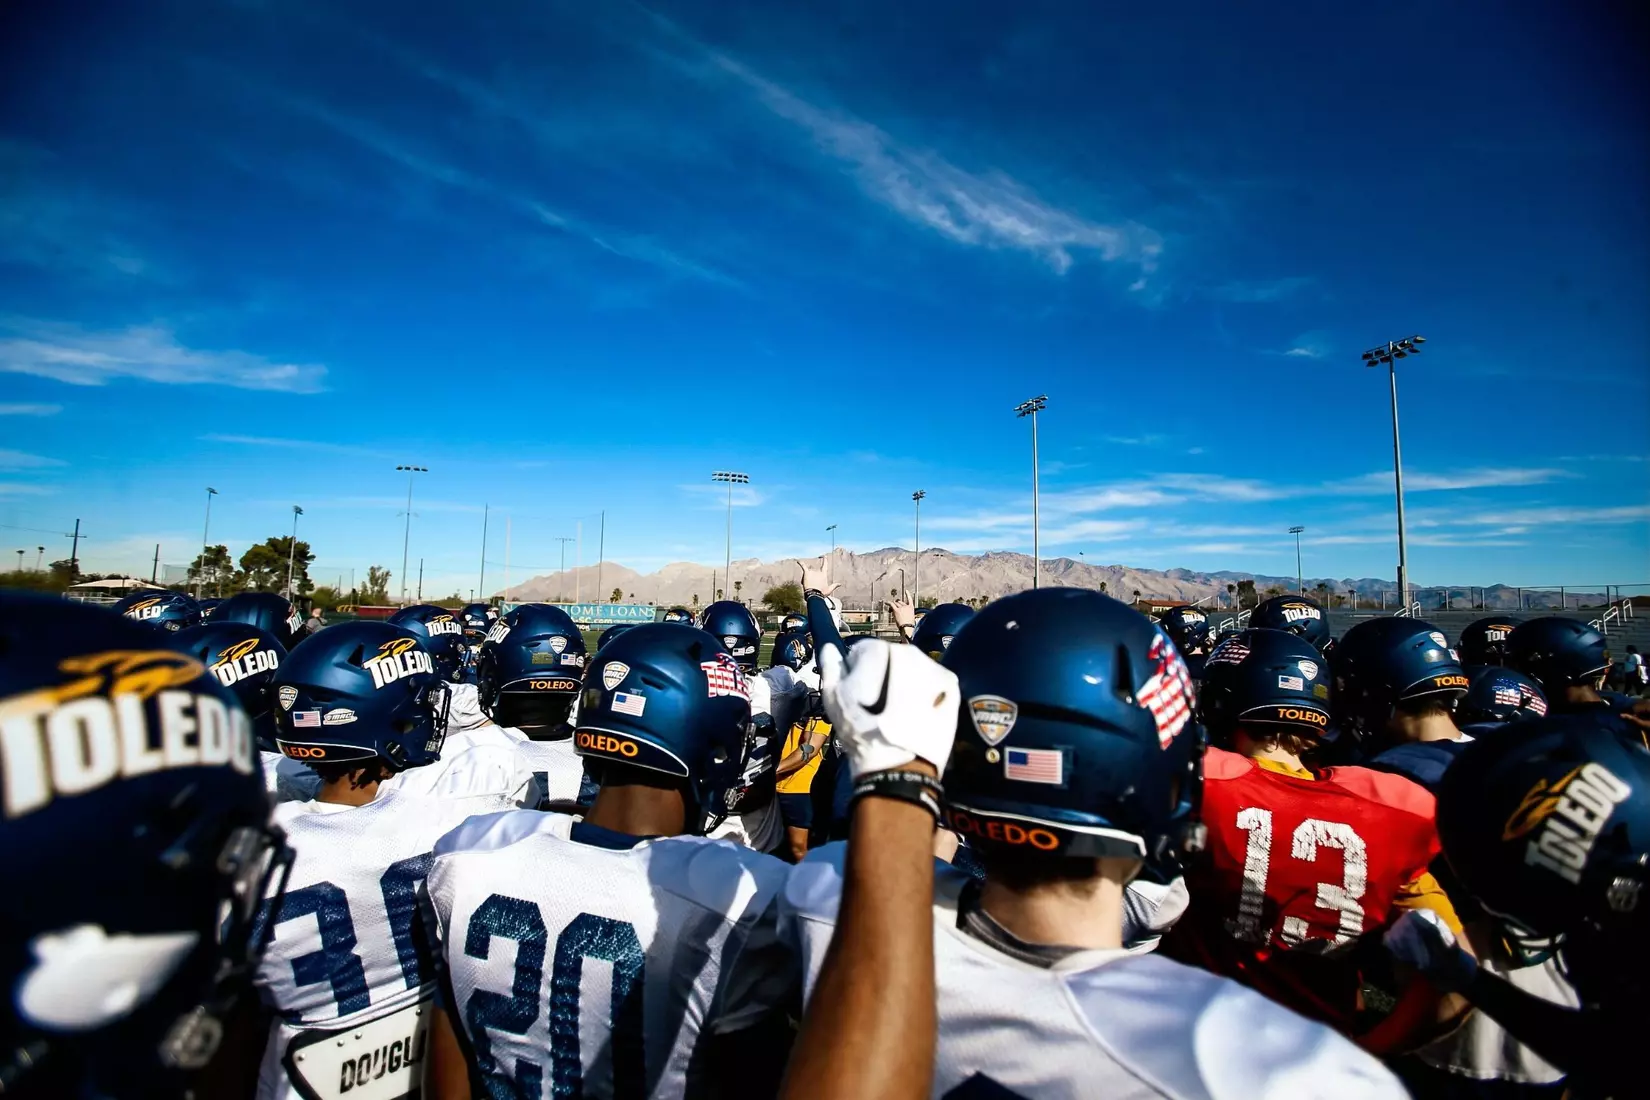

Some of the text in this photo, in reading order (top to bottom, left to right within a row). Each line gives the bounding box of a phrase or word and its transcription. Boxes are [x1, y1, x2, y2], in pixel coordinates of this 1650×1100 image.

[560, 605, 656, 617] HOME LOANS
[1281, 607, 1321, 624] TOLEDO
[424, 621, 462, 638] TOLEDO
[363, 650, 434, 690] TOLEDO
[529, 680, 575, 691] TOLEDO
[1278, 708, 1327, 726] TOLEDO
[0, 688, 254, 820] TOLEDO
[576, 732, 639, 758] TOLEDO
[952, 811, 1060, 851] OLEDO
[1524, 761, 1632, 886] TOLEDO
[1235, 806, 1368, 954] 13
[464, 893, 646, 1100] 20
